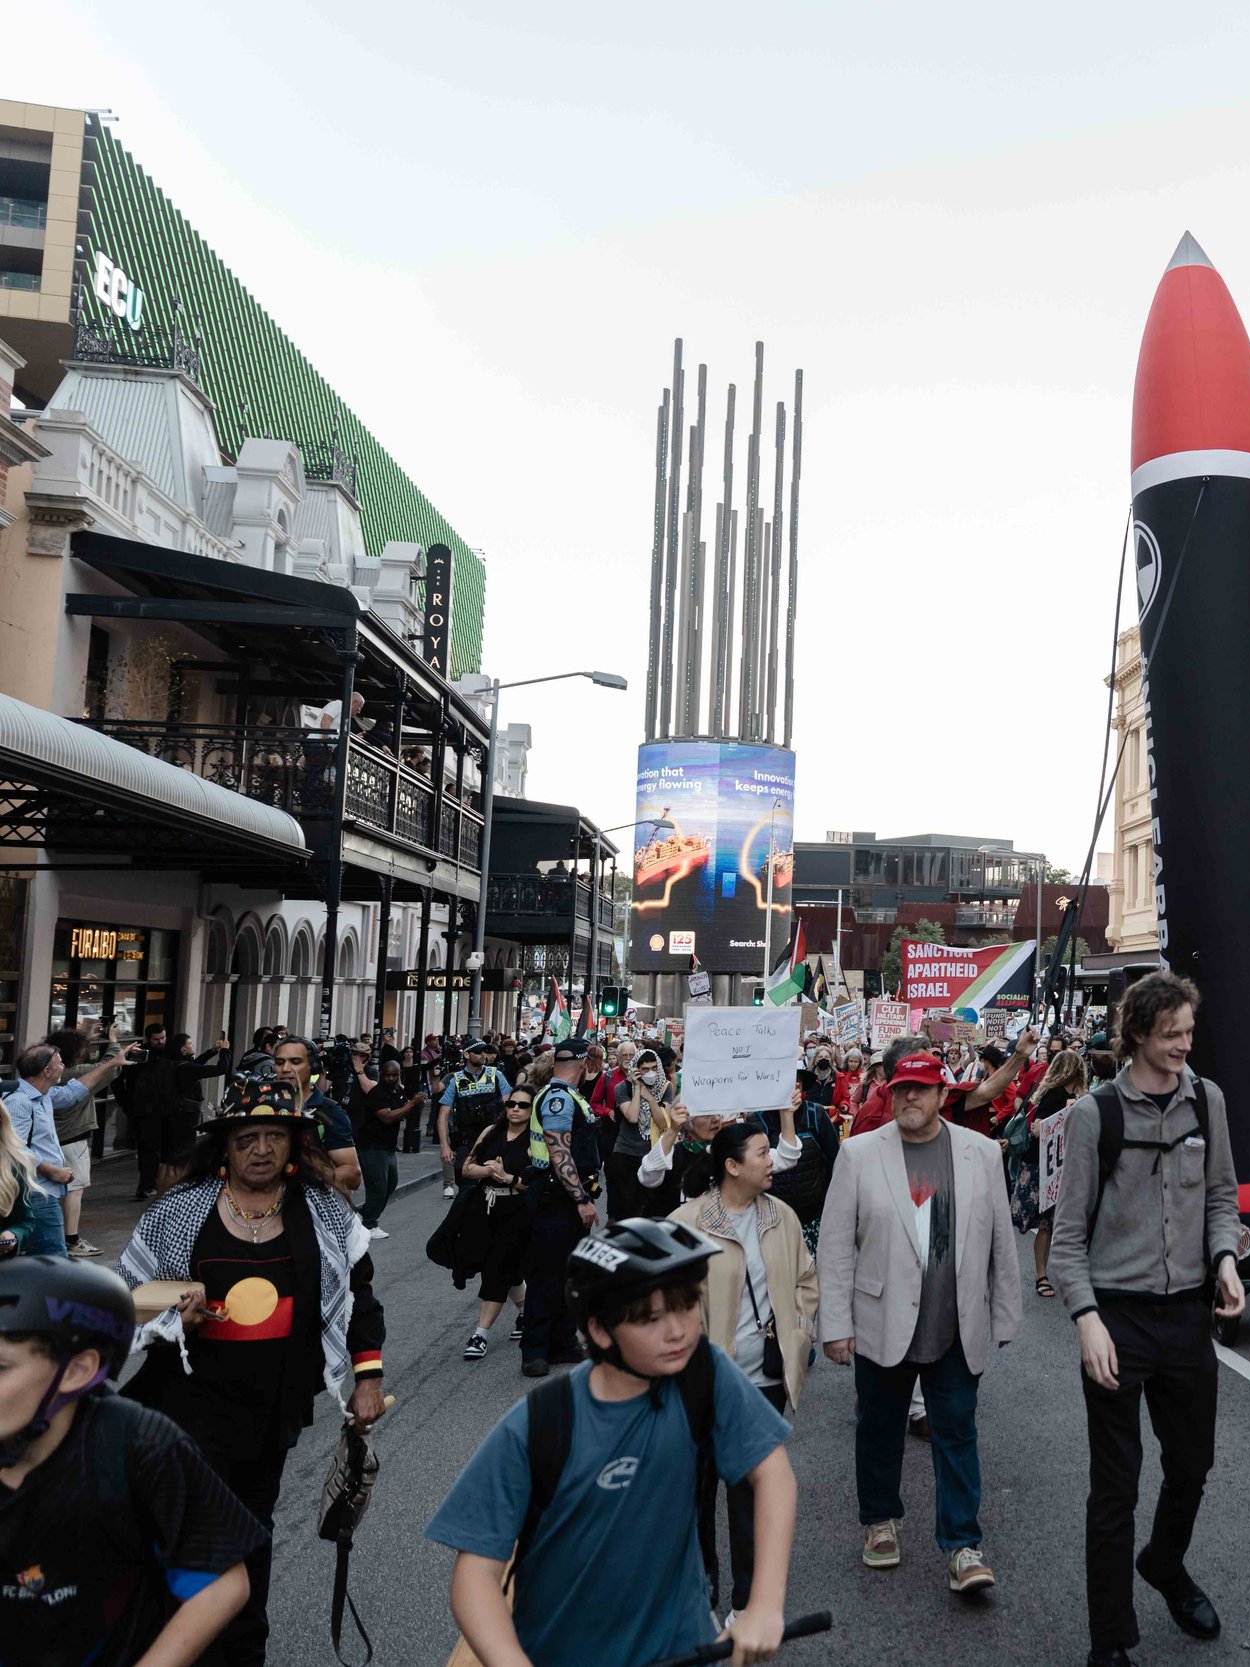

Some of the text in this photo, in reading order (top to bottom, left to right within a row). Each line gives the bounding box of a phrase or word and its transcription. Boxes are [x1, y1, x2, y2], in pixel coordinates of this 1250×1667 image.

[95, 250, 143, 331] ECU
[661, 766, 684, 777] that
[659, 778, 702, 792] flowing
[735, 779, 769, 795] keeps
[70, 928, 117, 960] FURAIBO
[672, 934, 692, 944] 125
[729, 940, 756, 948] Search:
[907, 962, 978, 979] APARTHEID
[907, 983, 951, 999] ISRAEL
[876, 1012, 906, 1020] MILITARY
[881, 1005, 901, 1013] CUT
[707, 1022, 777, 1037] Peace Talks
[732, 1045, 751, 1055] NOT
[692, 1074, 734, 1088] Weapons
[755, 1069, 780, 1083] Wars!
